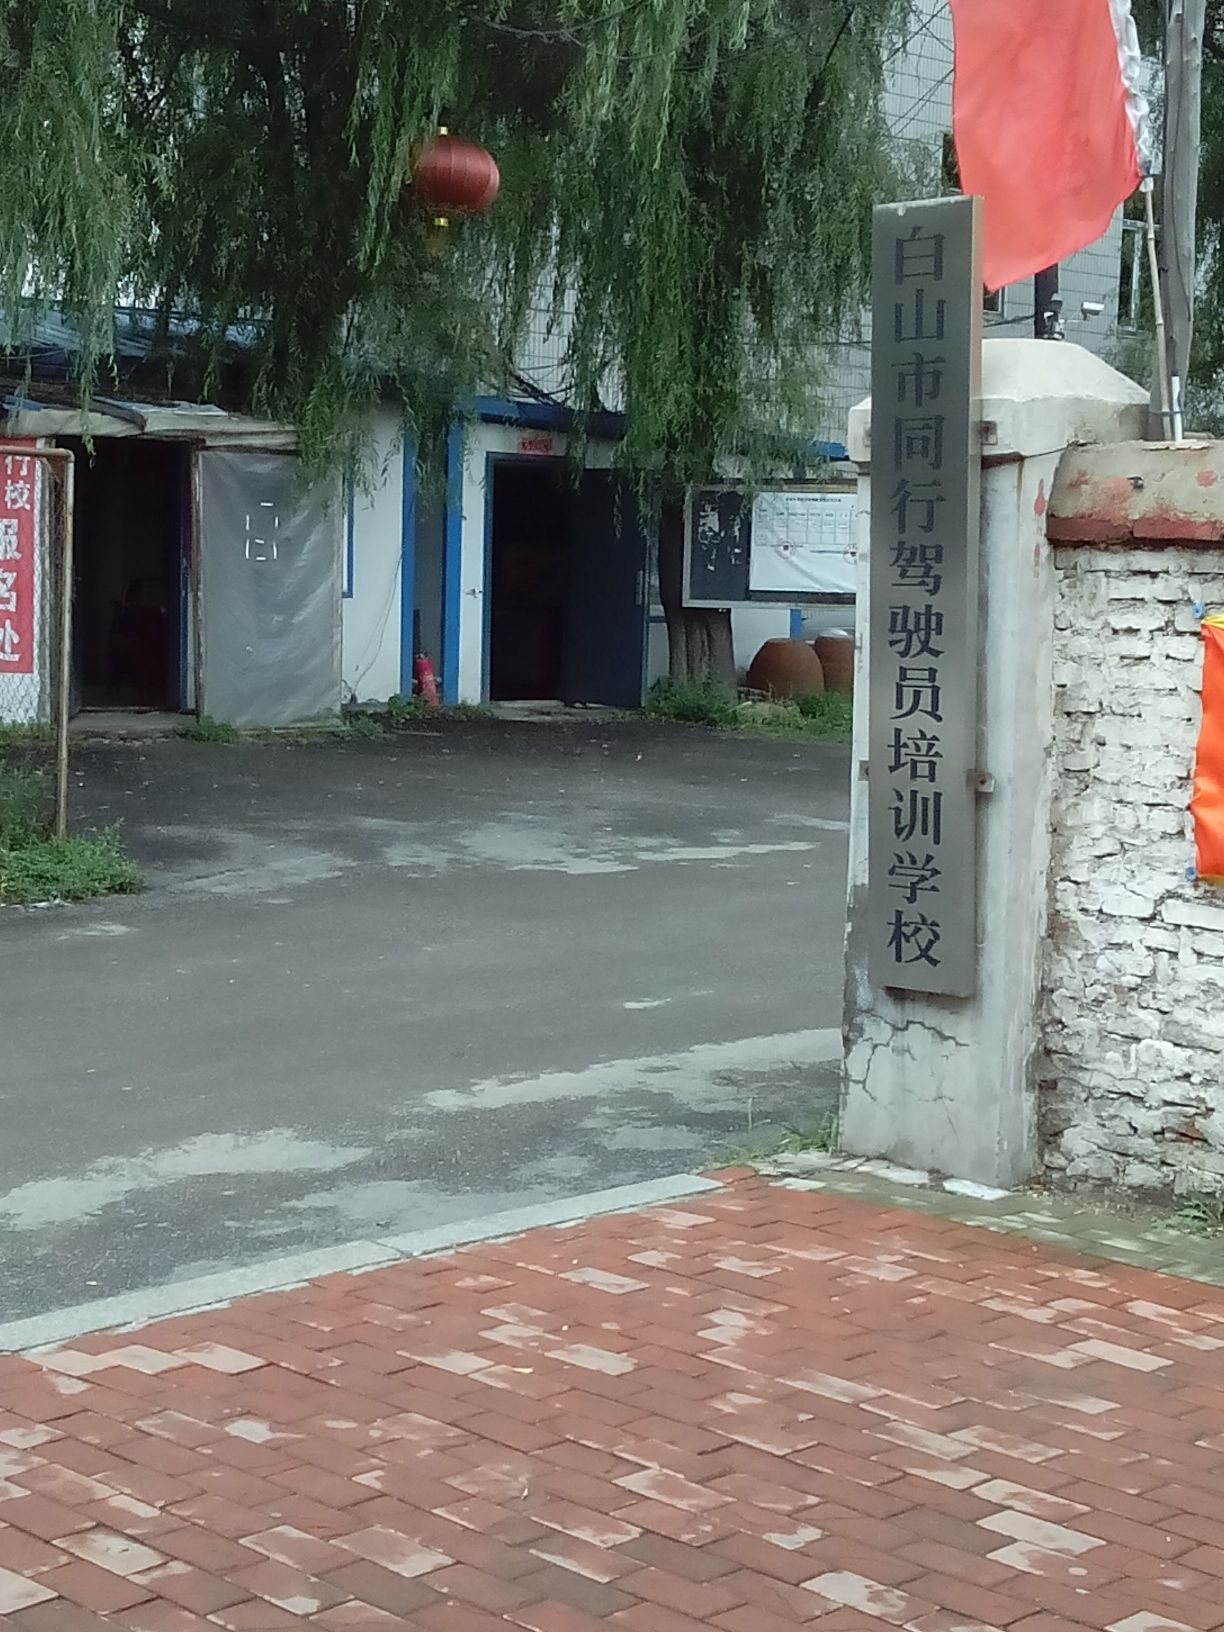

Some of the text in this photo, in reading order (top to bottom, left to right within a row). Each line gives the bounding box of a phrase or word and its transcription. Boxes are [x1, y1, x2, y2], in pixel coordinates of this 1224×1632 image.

[887, 226, 946, 967] 白山市同行驾驶员培训学校
